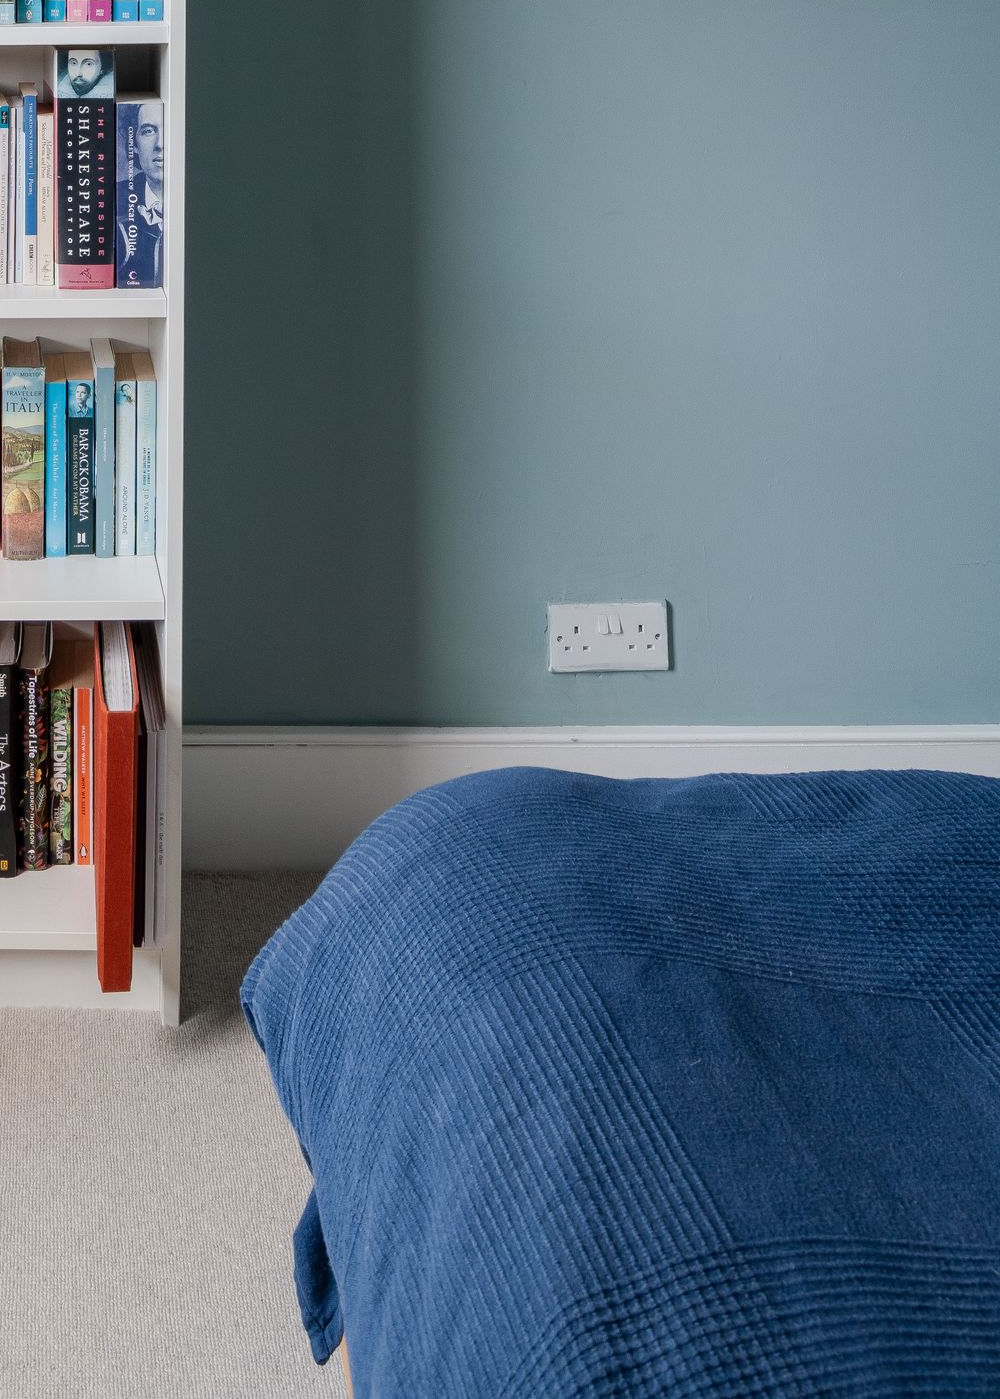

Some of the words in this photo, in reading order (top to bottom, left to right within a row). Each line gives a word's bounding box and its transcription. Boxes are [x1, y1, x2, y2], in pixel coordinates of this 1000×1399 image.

[79, 106, 90, 257] SHAKESPEARE
[128, 182, 134, 190] OF
[128, 194, 138, 222] Oscar
[128, 225, 138, 256] Wilde
[6, 402, 42, 412] ITALY
[79, 428, 89, 475] BARACK
[79, 477, 89, 521] OBAMA
[0, 674, 7, 697] Smith
[28, 675, 38, 726] Tapestries
[28, 728, 37, 736] of
[28, 740, 37, 758] Life
[53, 718, 66, 792] WILDING
